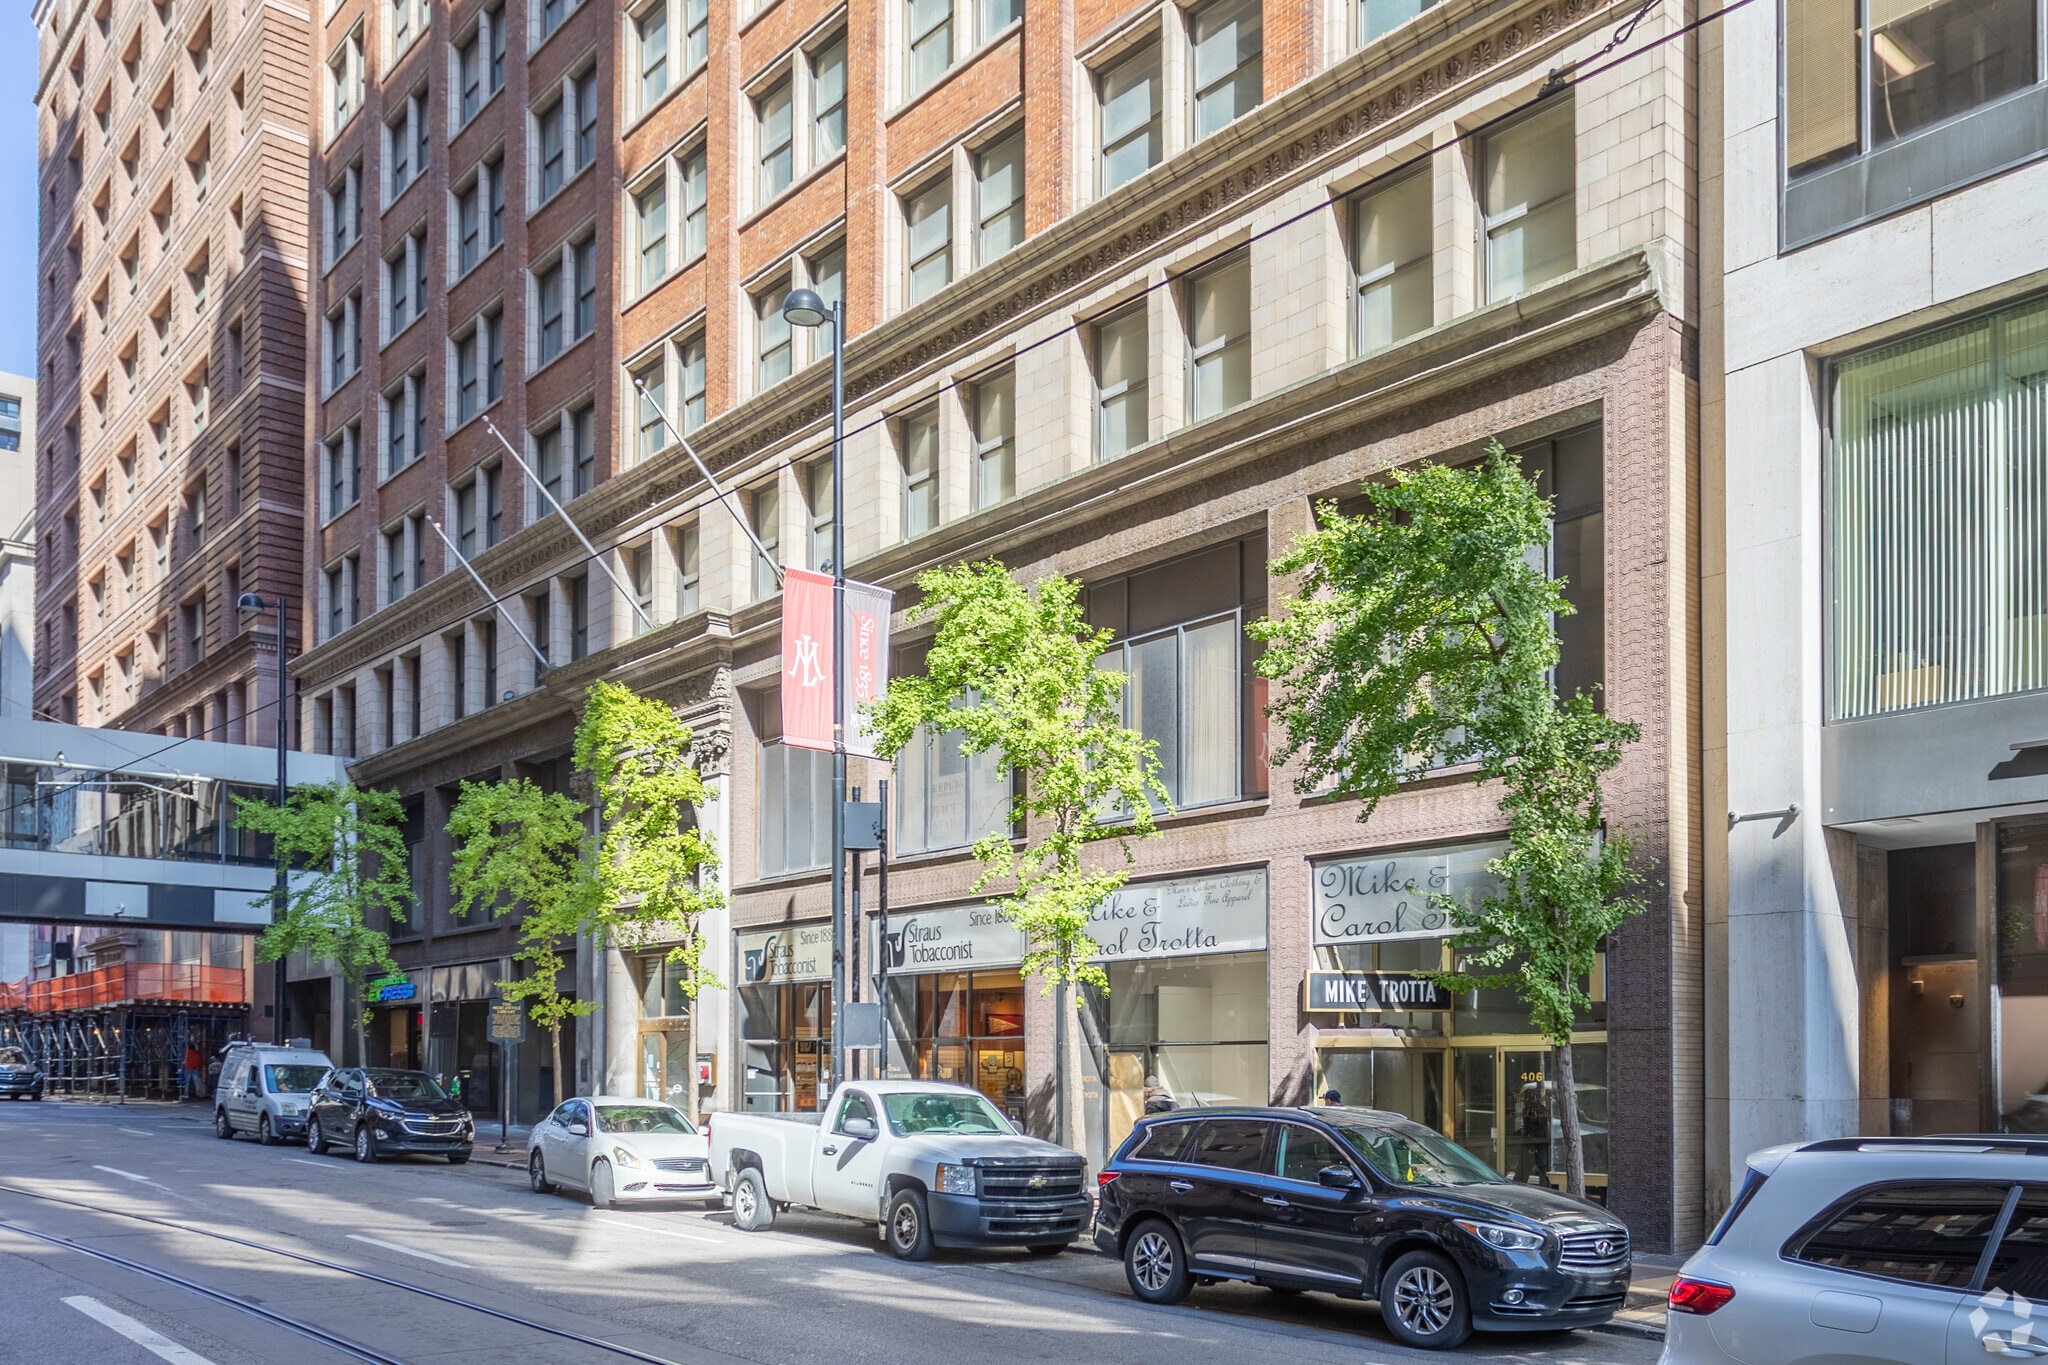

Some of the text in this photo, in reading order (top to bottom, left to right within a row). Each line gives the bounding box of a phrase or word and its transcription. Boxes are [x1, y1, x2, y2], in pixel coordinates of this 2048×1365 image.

[859, 616, 875, 660] Since
[855, 665, 873, 699] 1835
[1219, 873, 1251, 891] Clothing
[1320, 861, 1450, 898] Mike &
[969, 911, 992, 926] Since
[1086, 892, 1160, 922] ike &
[1320, 901, 1407, 938] Carol
[800, 928, 833, 945] Since 188
[908, 924, 942, 943] Straus
[1138, 920, 1220, 953] Trotta
[769, 942, 794, 959] Straus
[910, 940, 973, 963] Tobacconist
[769, 957, 816, 976] Tobacconist
[1325, 980, 1437, 1003] MIKE TROTTA
[1521, 1072, 1543, 1082] 406
